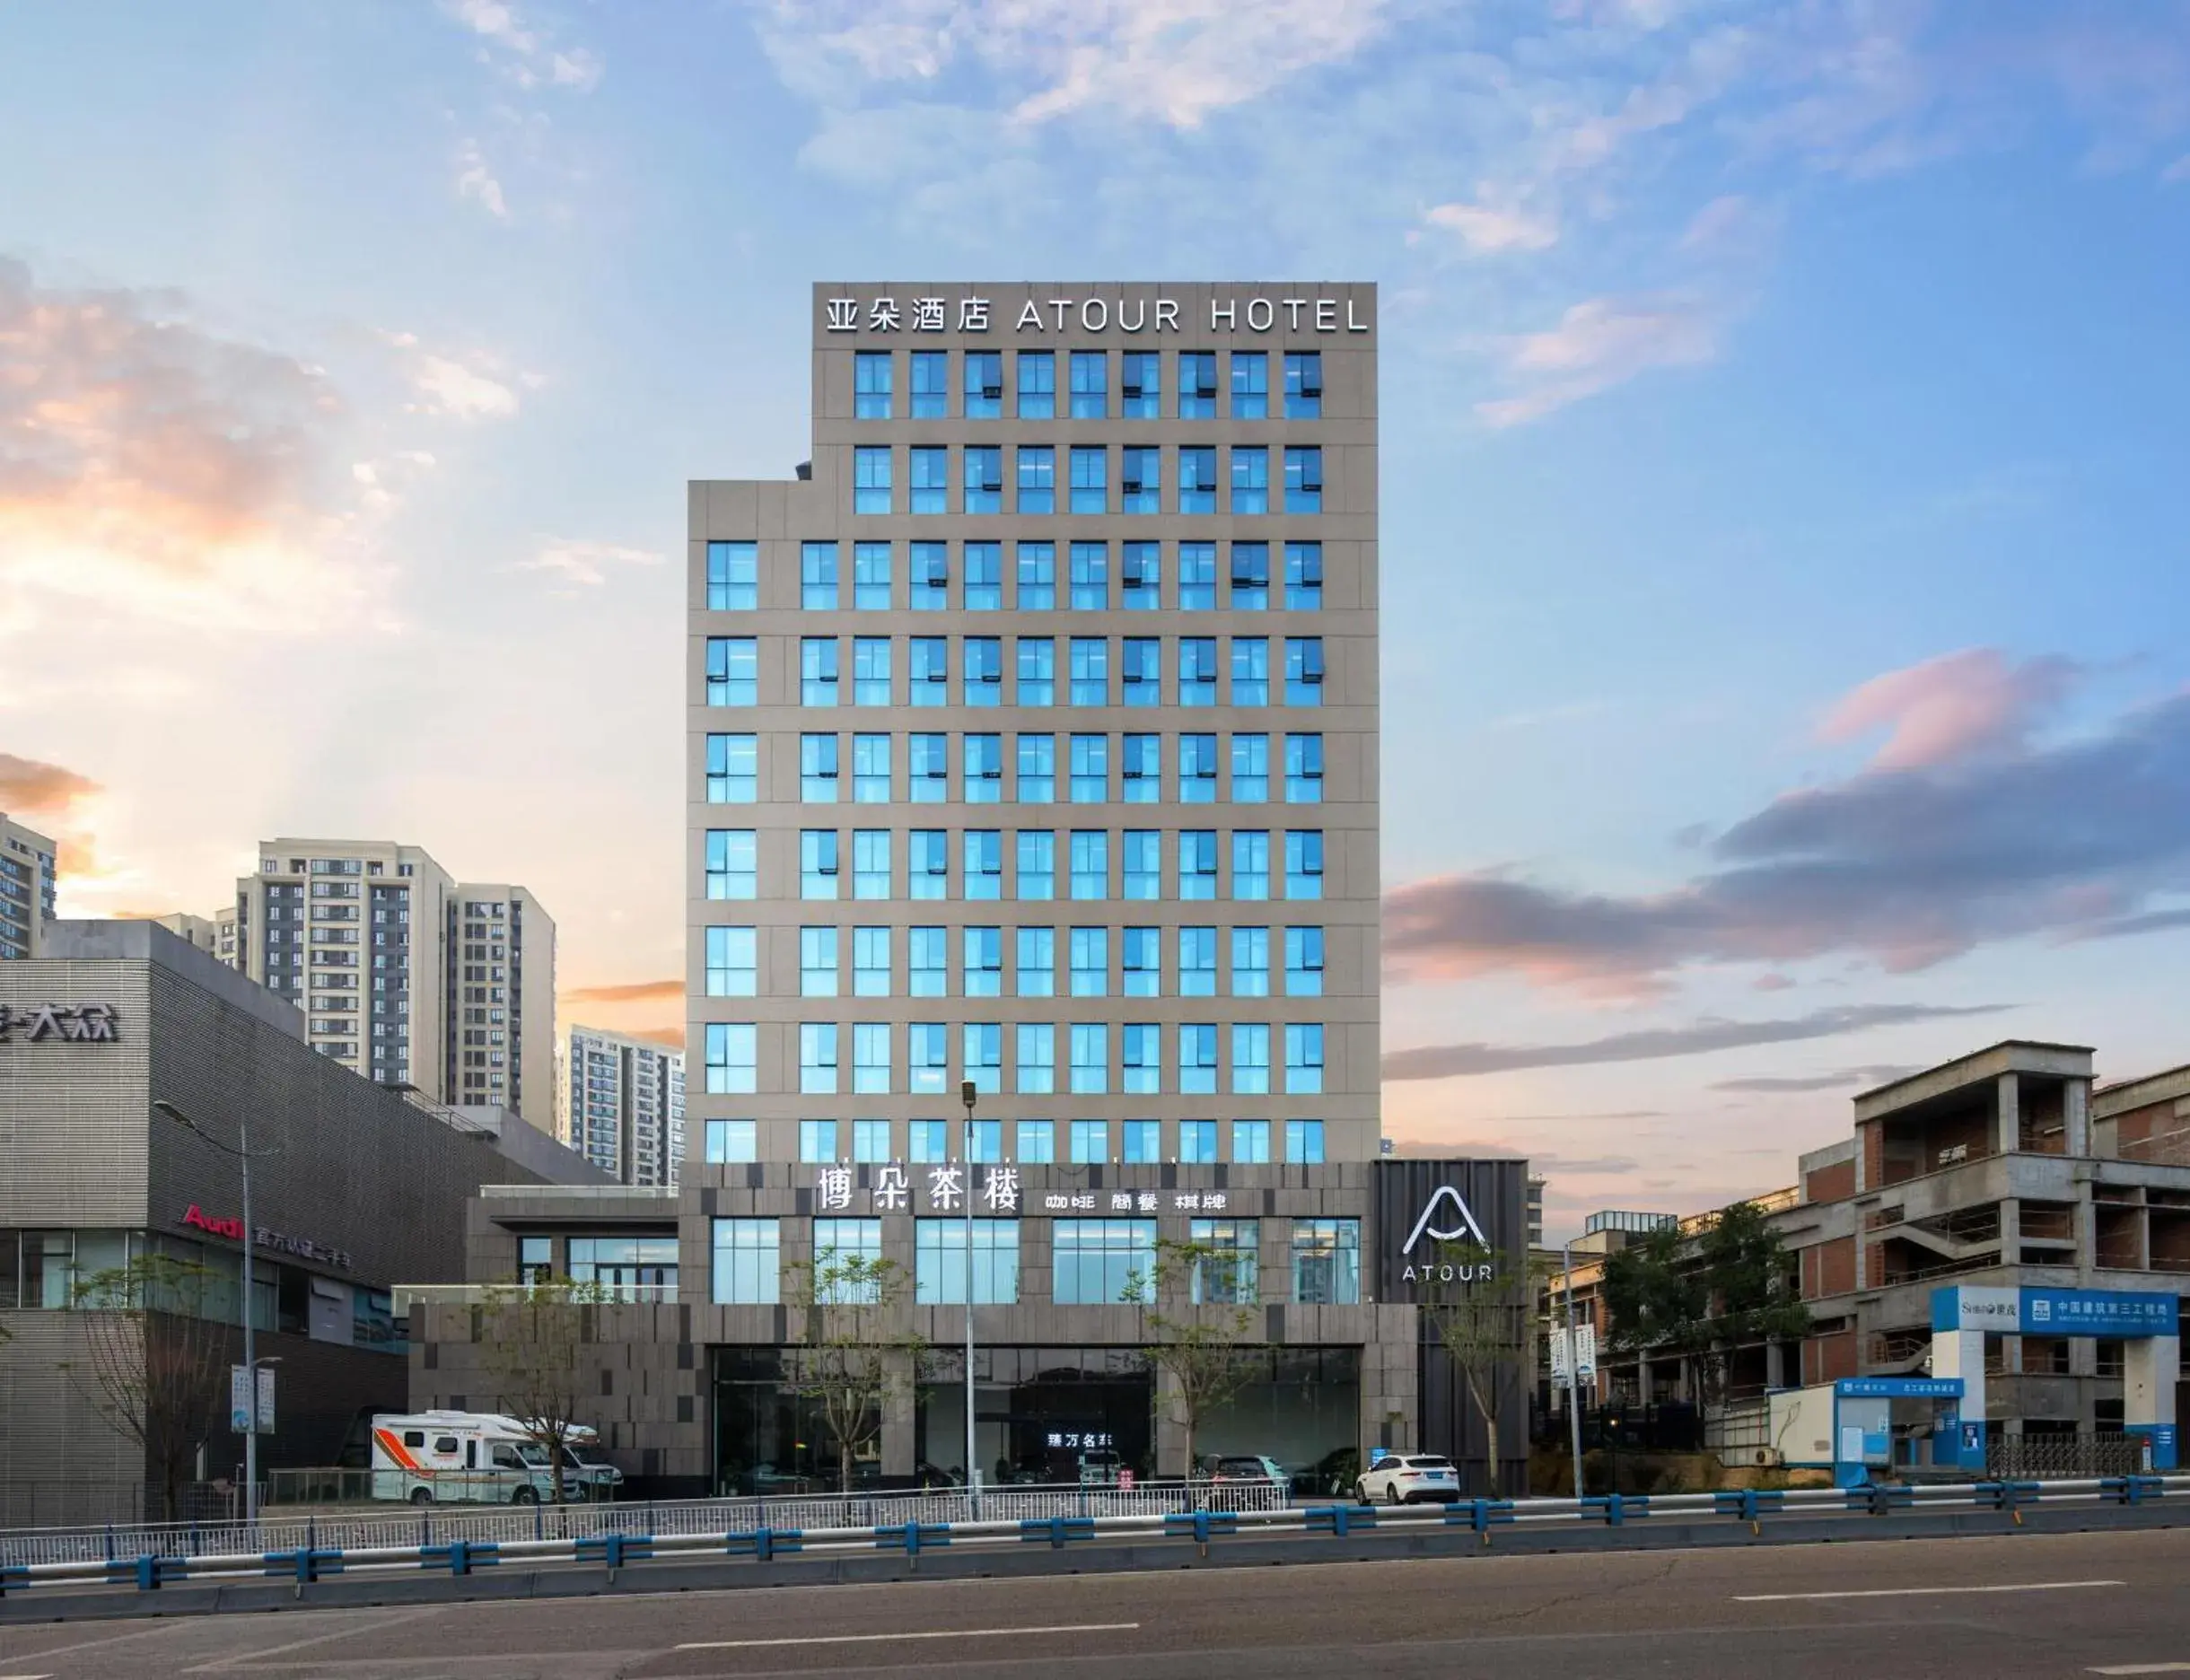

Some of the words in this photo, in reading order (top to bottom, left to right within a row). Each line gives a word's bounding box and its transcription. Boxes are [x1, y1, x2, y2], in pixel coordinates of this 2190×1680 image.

[827, 296, 990, 330] 亚朵酒店
[1016, 298, 1180, 331] ATOUR
[1212, 298, 1368, 331] HOTEL
[819, 1166, 1021, 1211] 博朵茶楼
[1402, 1264, 1493, 1282] ATOUR
